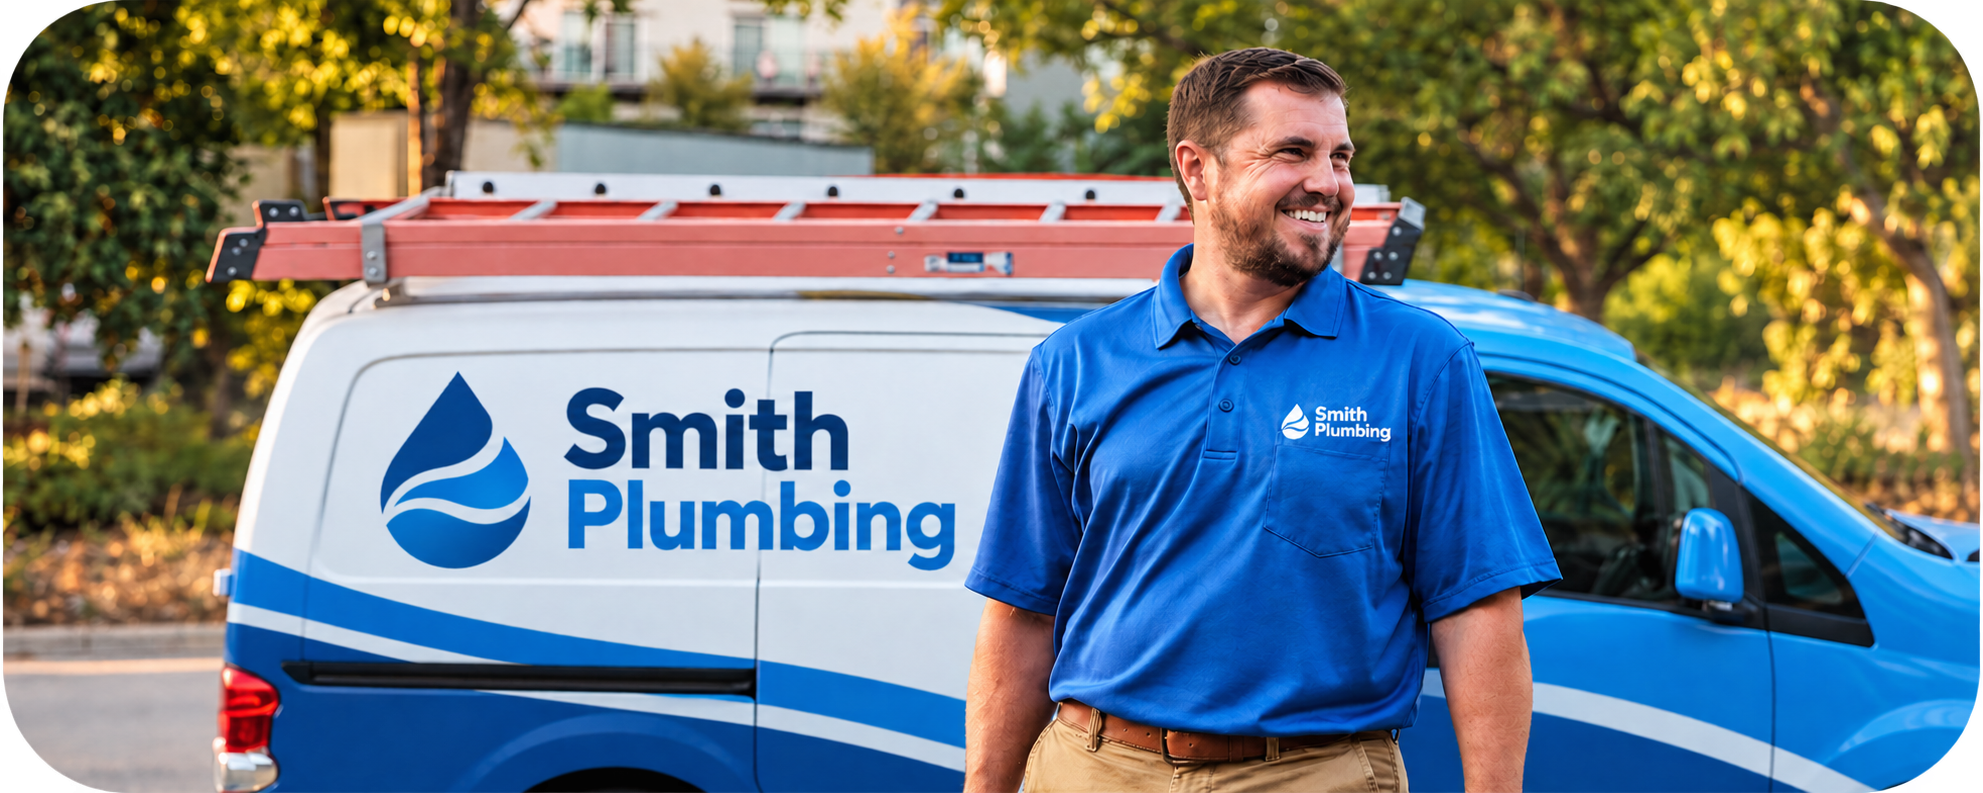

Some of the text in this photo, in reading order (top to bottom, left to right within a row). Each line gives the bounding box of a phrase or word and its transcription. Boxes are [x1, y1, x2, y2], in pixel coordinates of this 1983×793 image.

[564, 387, 849, 472] Smith
[1315, 405, 1368, 422] Smith
[1315, 422, 1392, 443] Plumbing
[568, 479, 956, 571] Plumbing
